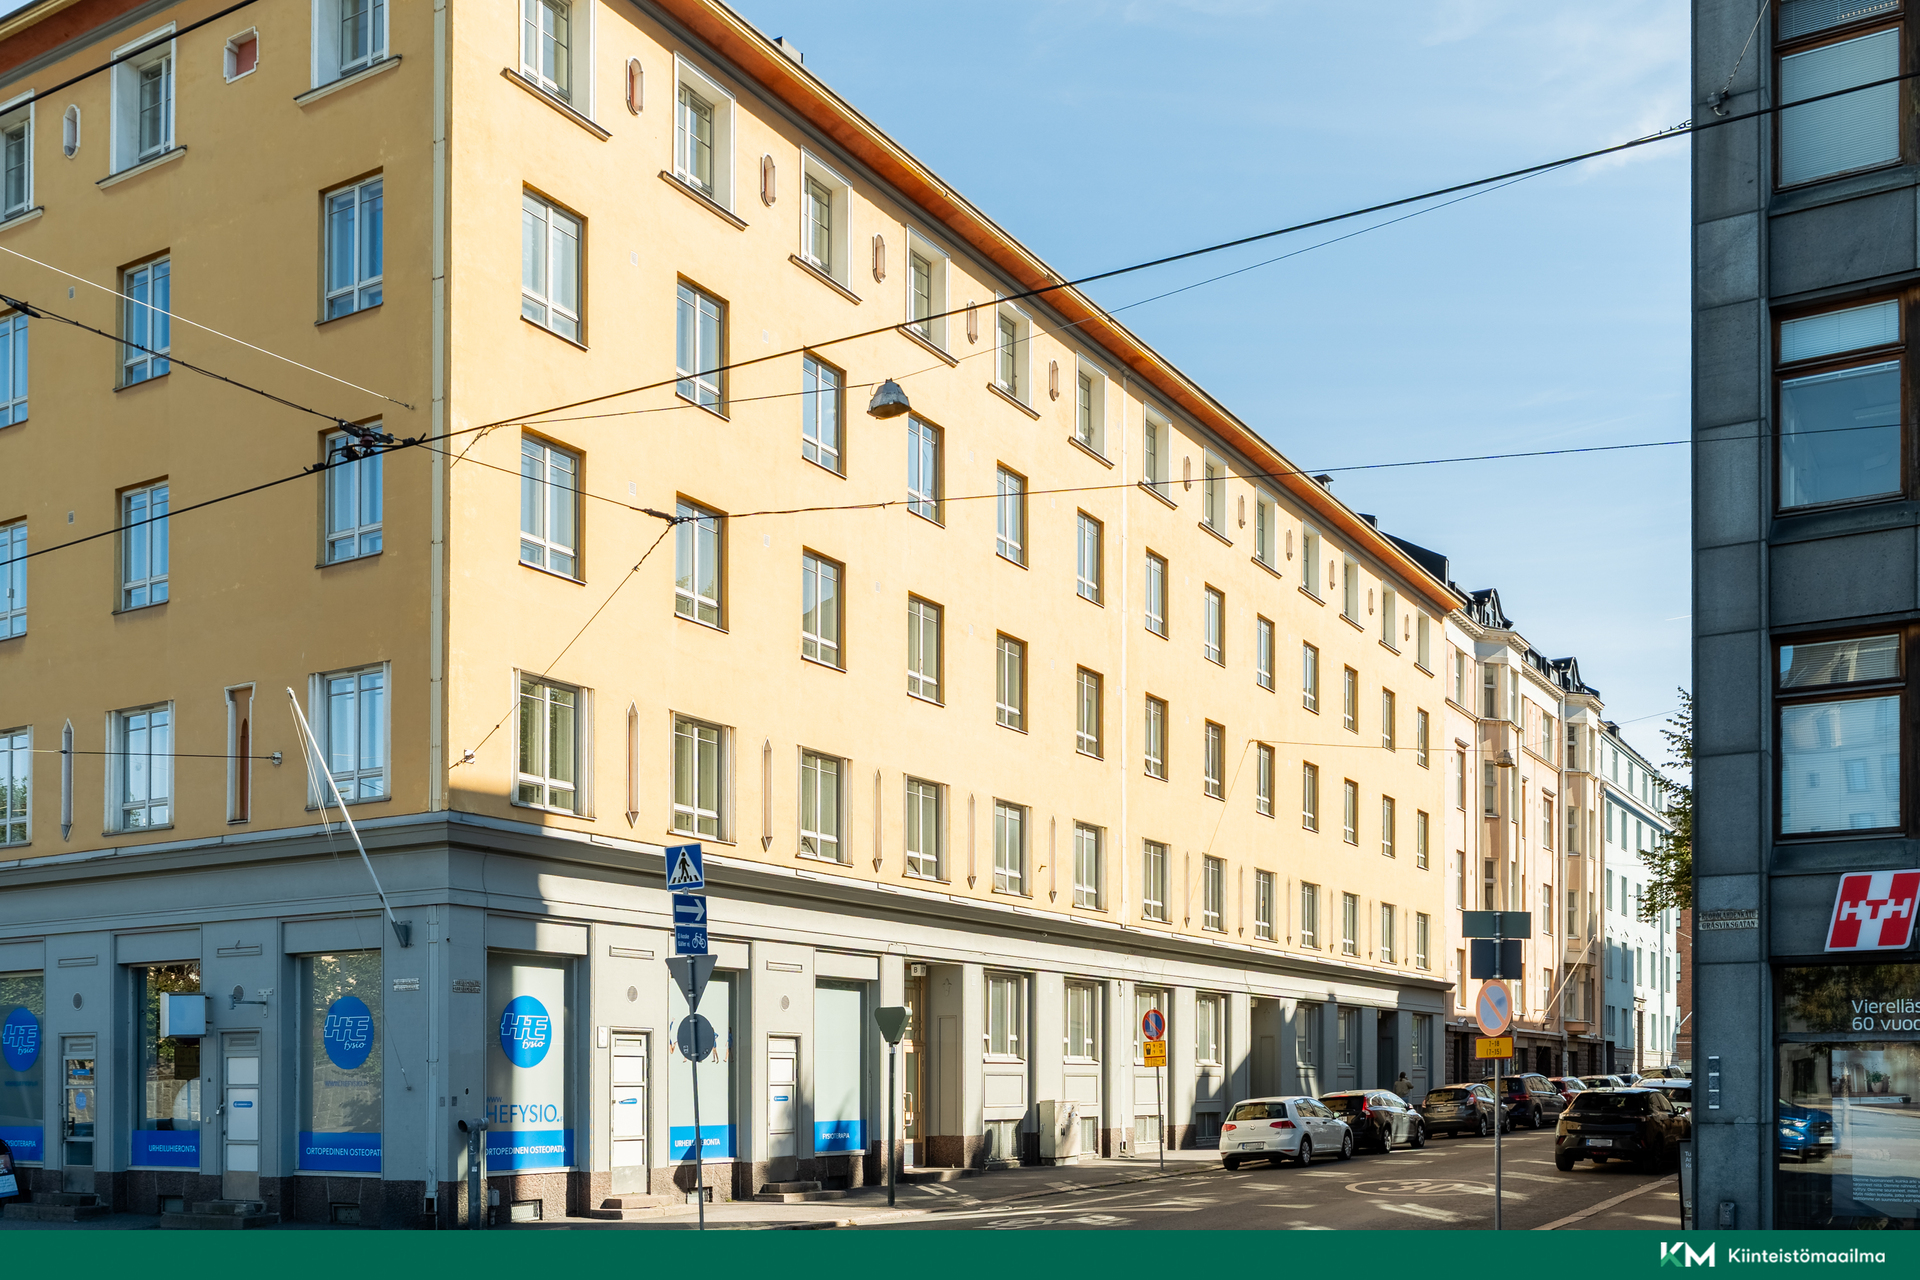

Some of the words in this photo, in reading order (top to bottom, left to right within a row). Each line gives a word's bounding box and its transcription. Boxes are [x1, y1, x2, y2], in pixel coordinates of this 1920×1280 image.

[913, 966, 919, 974] B
[1852, 1017, 1875, 1031] 60
[343, 1039, 367, 1051] fysio
[522, 1038, 546, 1050] fysio
[17, 1045, 35, 1056] fysio
[822, 1132, 851, 1140] FYSIOTERAPIA
[148, 1144, 197, 1153] URHEILUHIERONTA
[305, 1147, 349, 1156] ORTOPEDINEN
[485, 1146, 529, 1156] ORTOPEDINEN
[529, 1144, 567, 1155] OSTEOPATIA
[1377, 1181, 1465, 1194] 30
